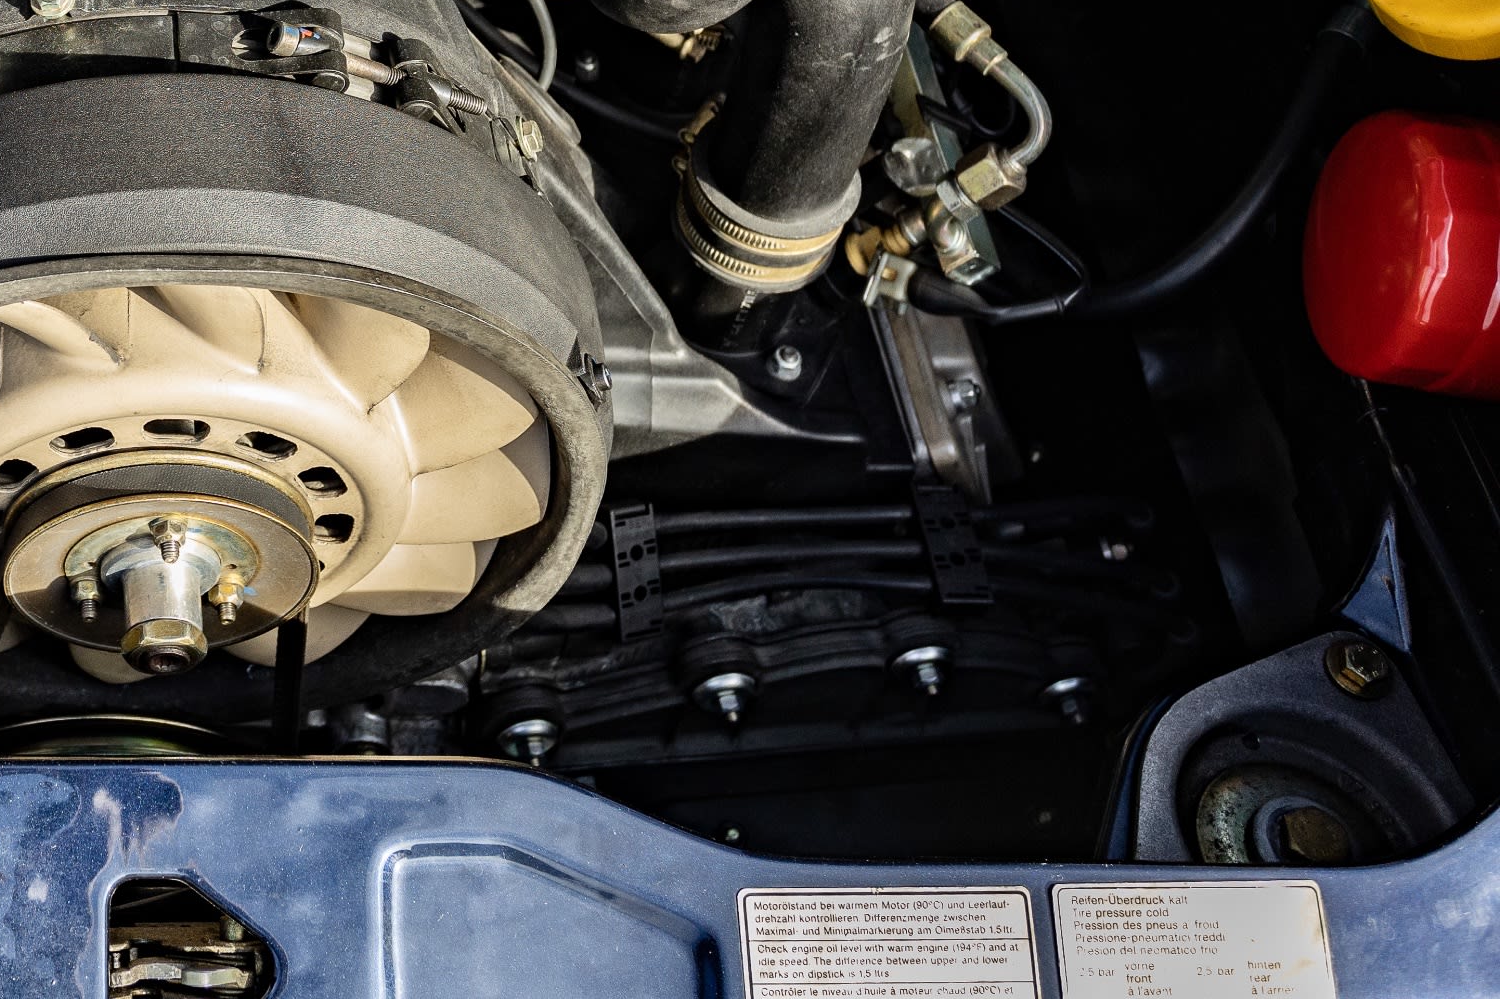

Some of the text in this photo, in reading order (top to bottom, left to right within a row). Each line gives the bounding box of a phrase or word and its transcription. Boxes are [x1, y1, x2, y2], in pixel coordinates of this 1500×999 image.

[1071, 893, 1189, 905] Reifen-Überdruck kalt
[753, 901, 817, 911] Motorölstand
[819, 901, 835, 910] bei
[838, 902, 878, 910] warmem
[881, 901, 910, 910] Motor
[947, 901, 965, 909] und
[755, 914, 796, 923] drehzahl
[864, 913, 940, 924] Differenzmenge
[943, 913, 986, 922] zwischen
[1095, 908, 1142, 920] pressure
[1146, 908, 1170, 918] cold
[756, 927, 799, 936] Maximal-
[802, 926, 820, 936] und
[917, 927, 932, 935] am
[1073, 920, 1119, 931] Pression
[1122, 920, 1142, 930] des
[1146, 921, 1178, 932] pneus
[757, 944, 788, 953] Check
[791, 945, 823, 955] engine
[826, 944, 838, 953] oil
[840, 944, 862, 953] level
[864, 944, 884, 953] with
[917, 944, 949, 954] engine
[988, 943, 1007, 952] and
[1009, 943, 1019, 952] at
[1120, 945, 1137, 955] del
[758, 957, 776, 966] idle
[813, 956, 832, 966] The
[835, 956, 883, 966] difference
[886, 956, 927, 965] between
[930, 957, 957, 966] upper
[961, 956, 979, 965] and
[982, 955, 1008, 964] lower
[759, 970, 789, 979] marks
[792, 971, 804, 979] on
[807, 970, 845, 980] dipstick
[1126, 973, 1153, 984] front
[761, 987, 807, 997] Contrôler
[809, 987, 819, 996] le
[821, 988, 853, 996] niveau
[899, 987, 933, 995] moteur
[1004, 986, 1014, 995] et
